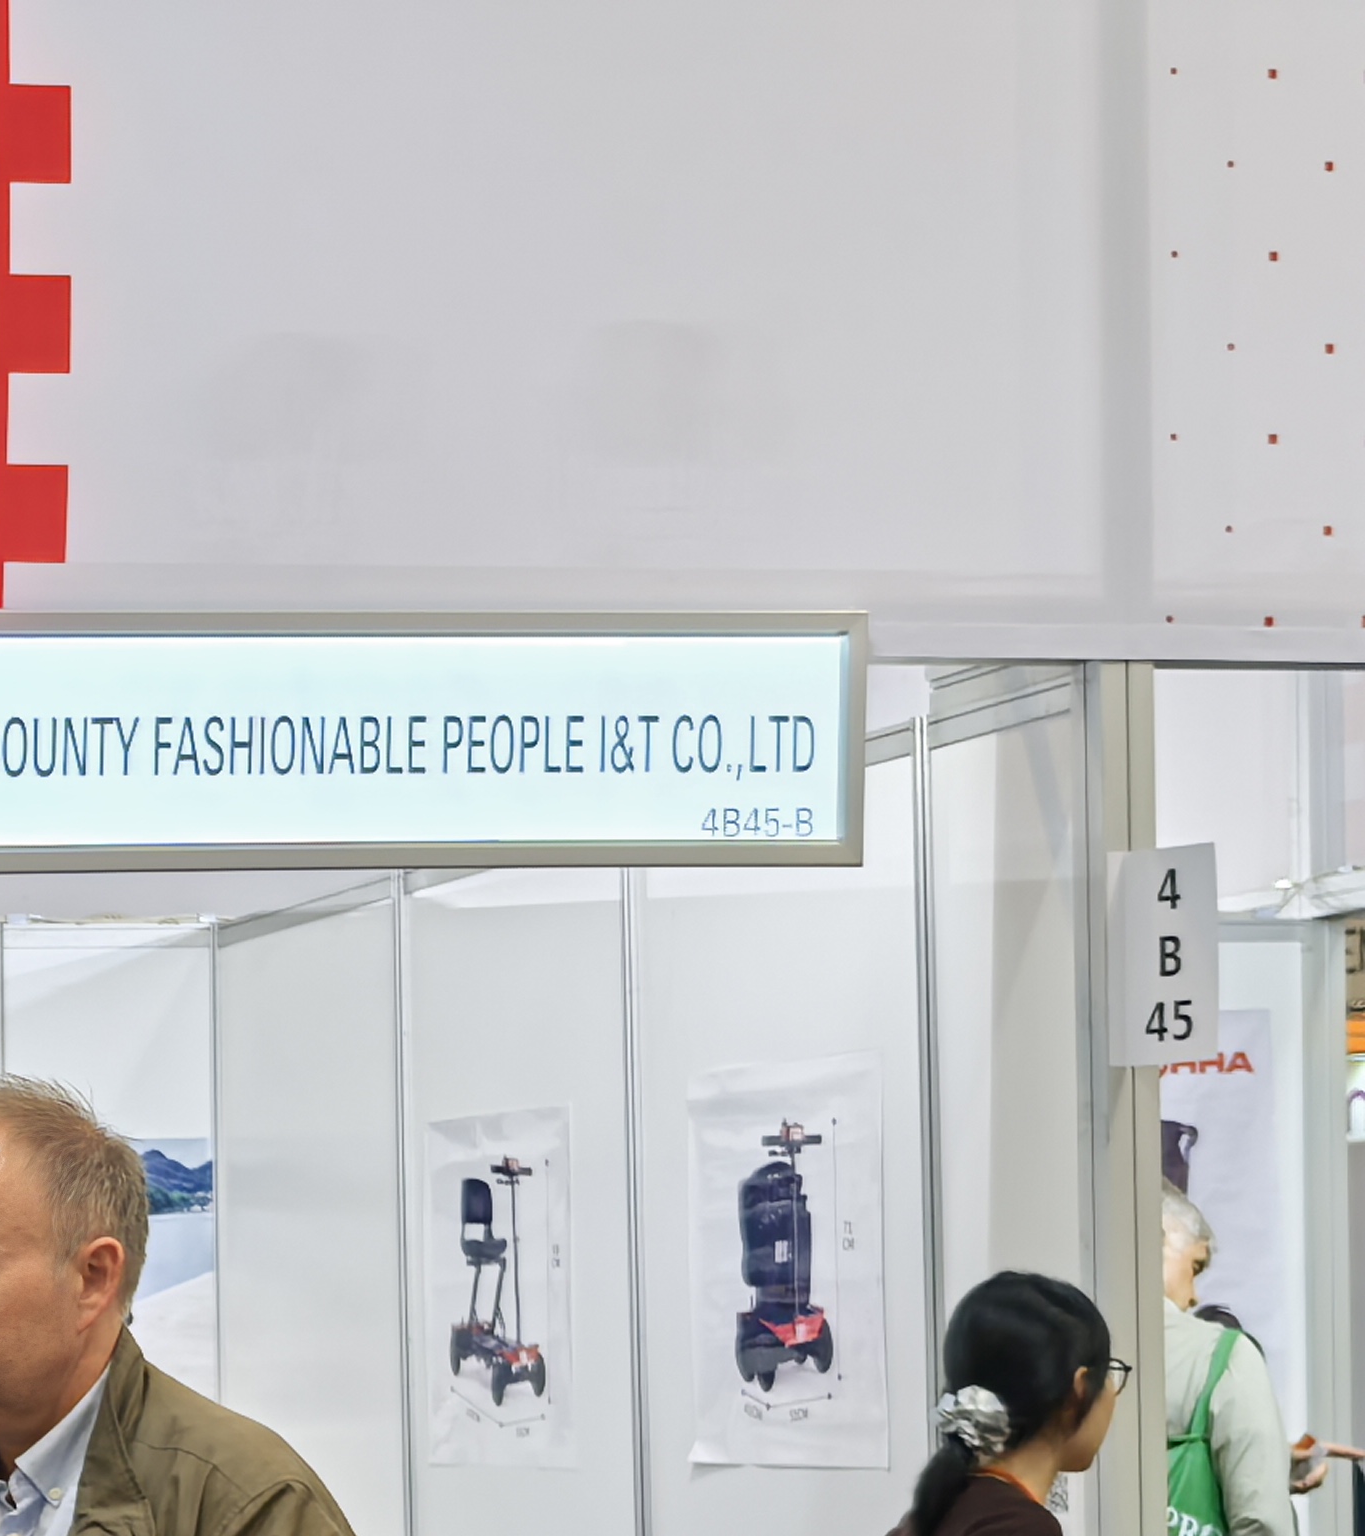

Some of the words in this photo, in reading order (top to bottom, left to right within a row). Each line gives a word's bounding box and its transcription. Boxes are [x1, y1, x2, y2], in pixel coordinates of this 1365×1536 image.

[154, 715, 428, 778] FASHIONABLE
[442, 714, 585, 776] PEOPLE
[599, 713, 659, 776] I&T
[701, 807, 815, 839] 4B45-B
[1156, 867, 1181, 911] 4
[1159, 936, 1182, 978] B
[1144, 1000, 1195, 1043] 45
